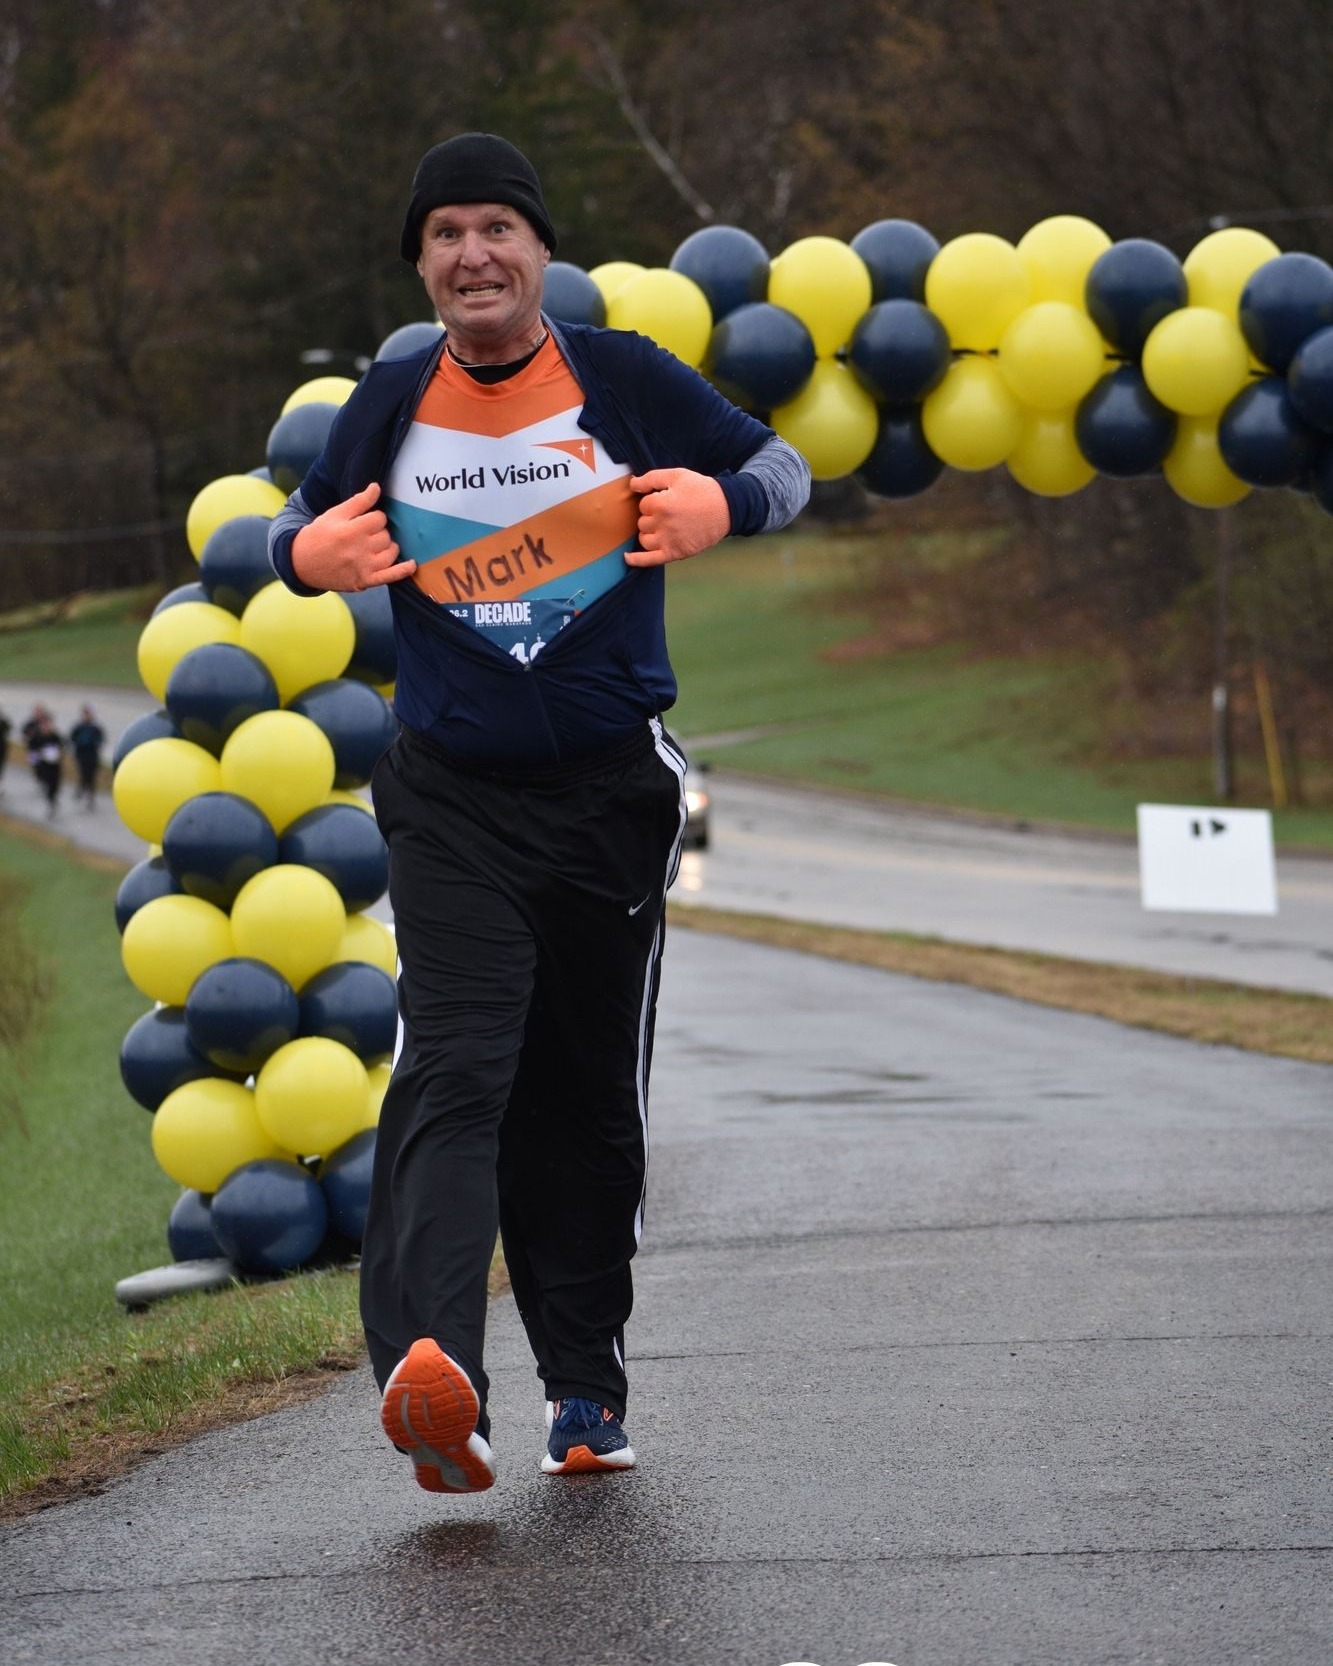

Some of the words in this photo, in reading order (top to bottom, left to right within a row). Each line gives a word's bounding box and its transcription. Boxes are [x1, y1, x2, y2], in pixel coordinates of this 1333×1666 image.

[415, 467, 485, 494] World
[492, 461, 570, 487] Vision
[443, 532, 555, 602] Mark
[474, 602, 532, 624] DECADE
